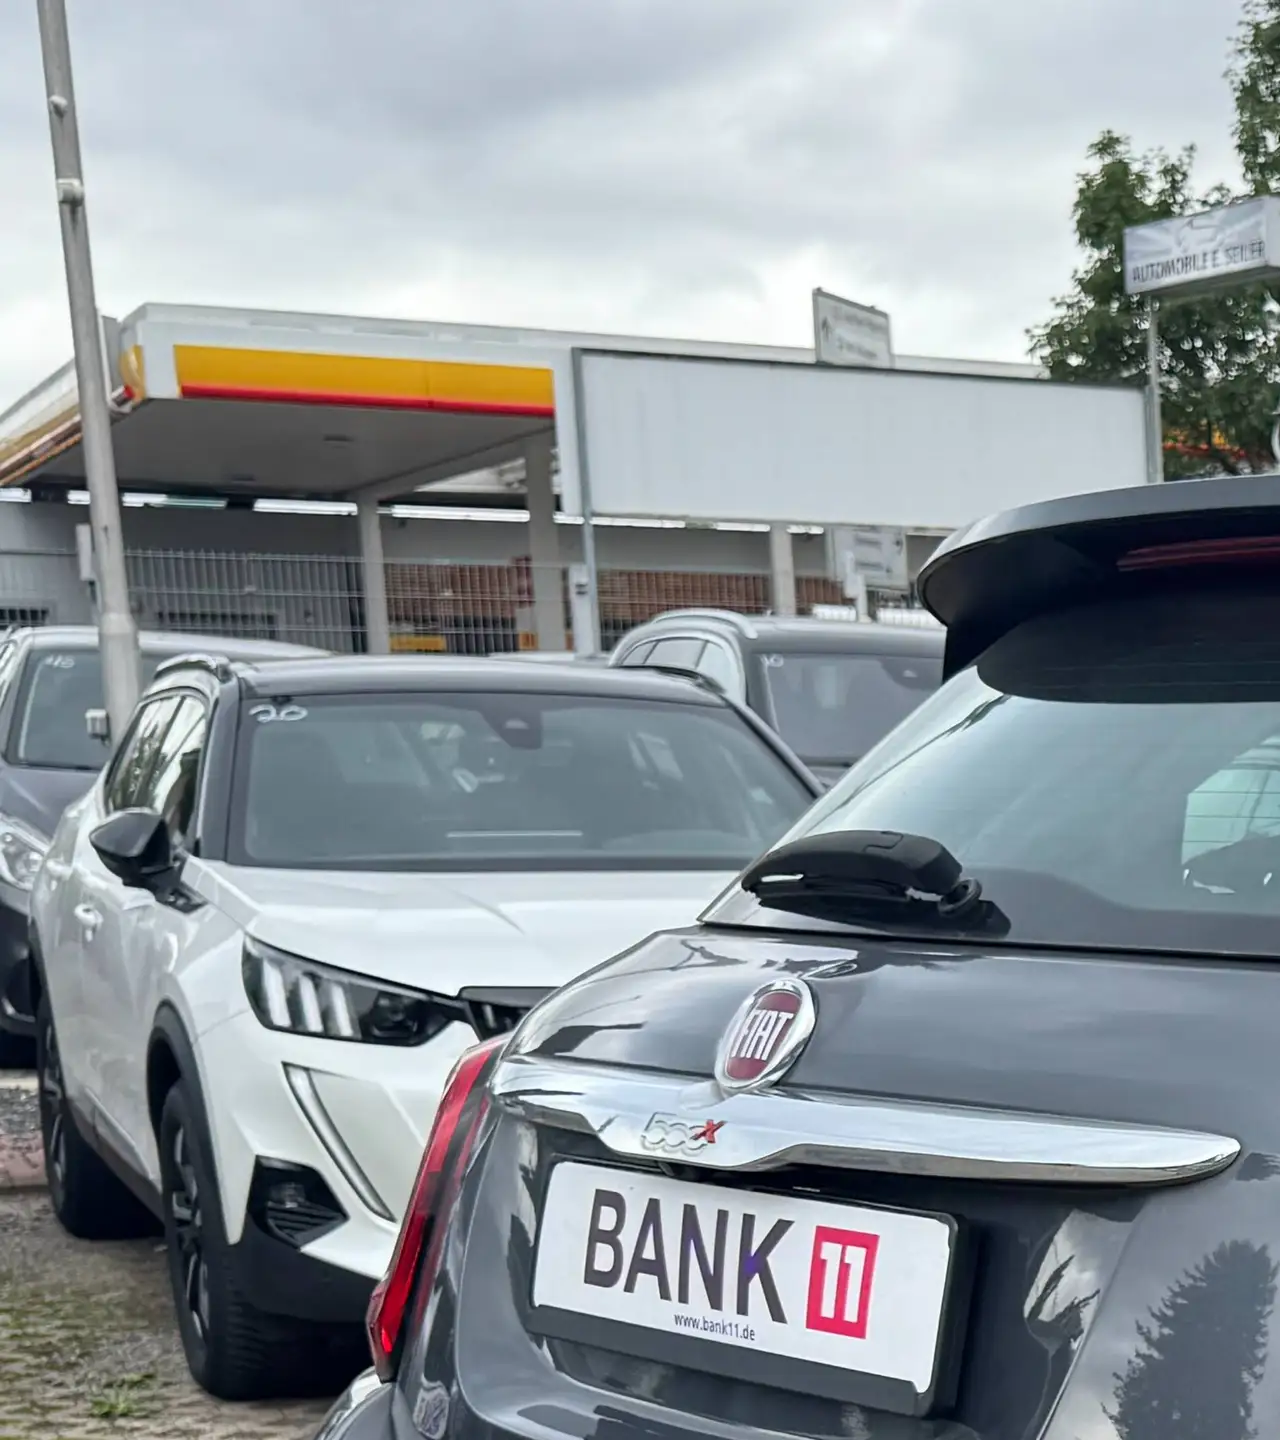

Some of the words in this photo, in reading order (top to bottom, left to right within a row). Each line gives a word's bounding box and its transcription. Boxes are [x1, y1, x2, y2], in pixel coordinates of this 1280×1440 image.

[731, 1009, 794, 1061] FIAT
[583, 1188, 795, 1325] BANK
[820, 1240, 869, 1324] 11
[673, 1312, 756, 1342] www.bank11.de
